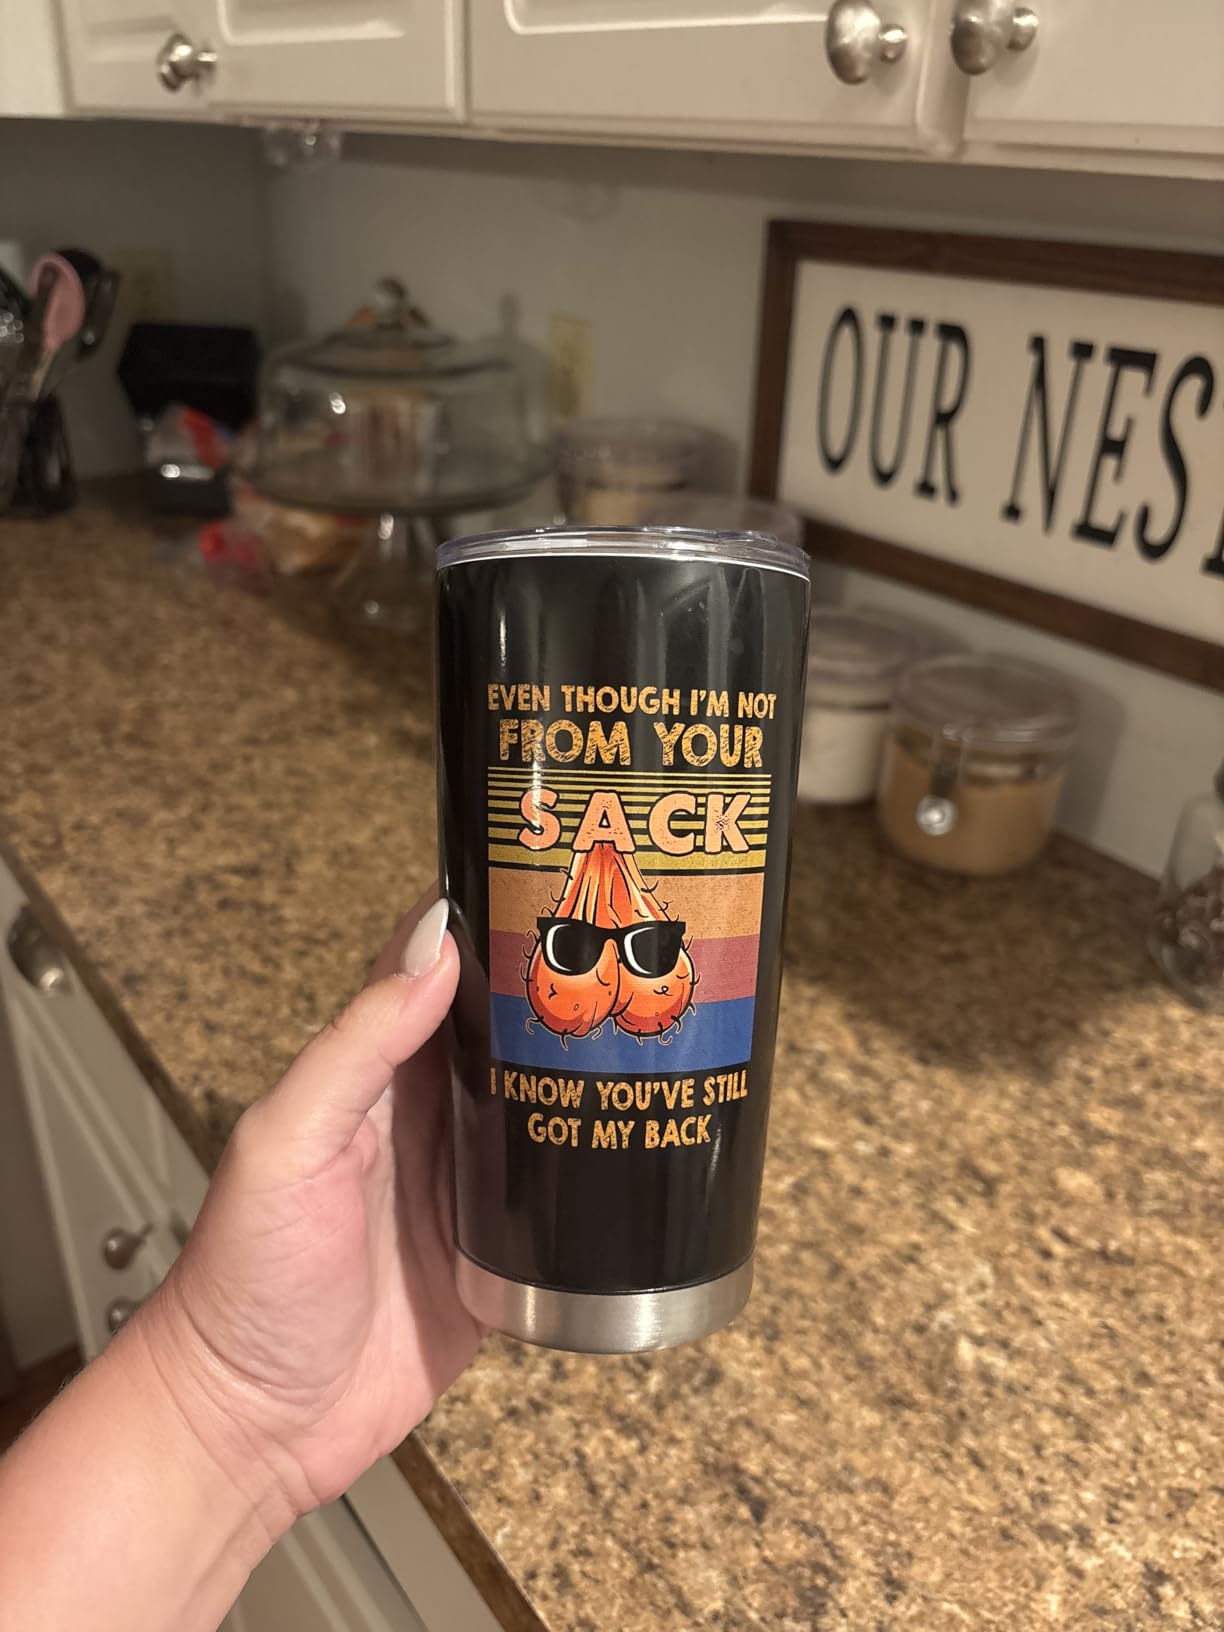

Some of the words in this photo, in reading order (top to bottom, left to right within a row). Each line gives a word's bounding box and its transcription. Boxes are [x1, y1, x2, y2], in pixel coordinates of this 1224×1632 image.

[818, 307, 971, 504] OUR
[1002, 334, 1224, 581] NES
[487, 683, 550, 711] EVEN
[561, 685, 680, 715] THOUGH
[690, 689, 729, 717] I'M
[738, 693, 776, 719] NOT
[499, 719, 631, 766] FROM
[654, 722, 763, 768] YOUR
[518, 788, 751, 854] SACK
[490, 1067, 497, 1095] I
[504, 1071, 585, 1108] KNOW
[596, 1078, 695, 1110] YOU'VE
[703, 1069, 748, 1106] STILL
[527, 1112, 582, 1147] GOT
[592, 1119, 635, 1149] MY
[645, 1114, 712, 1149] BACK
